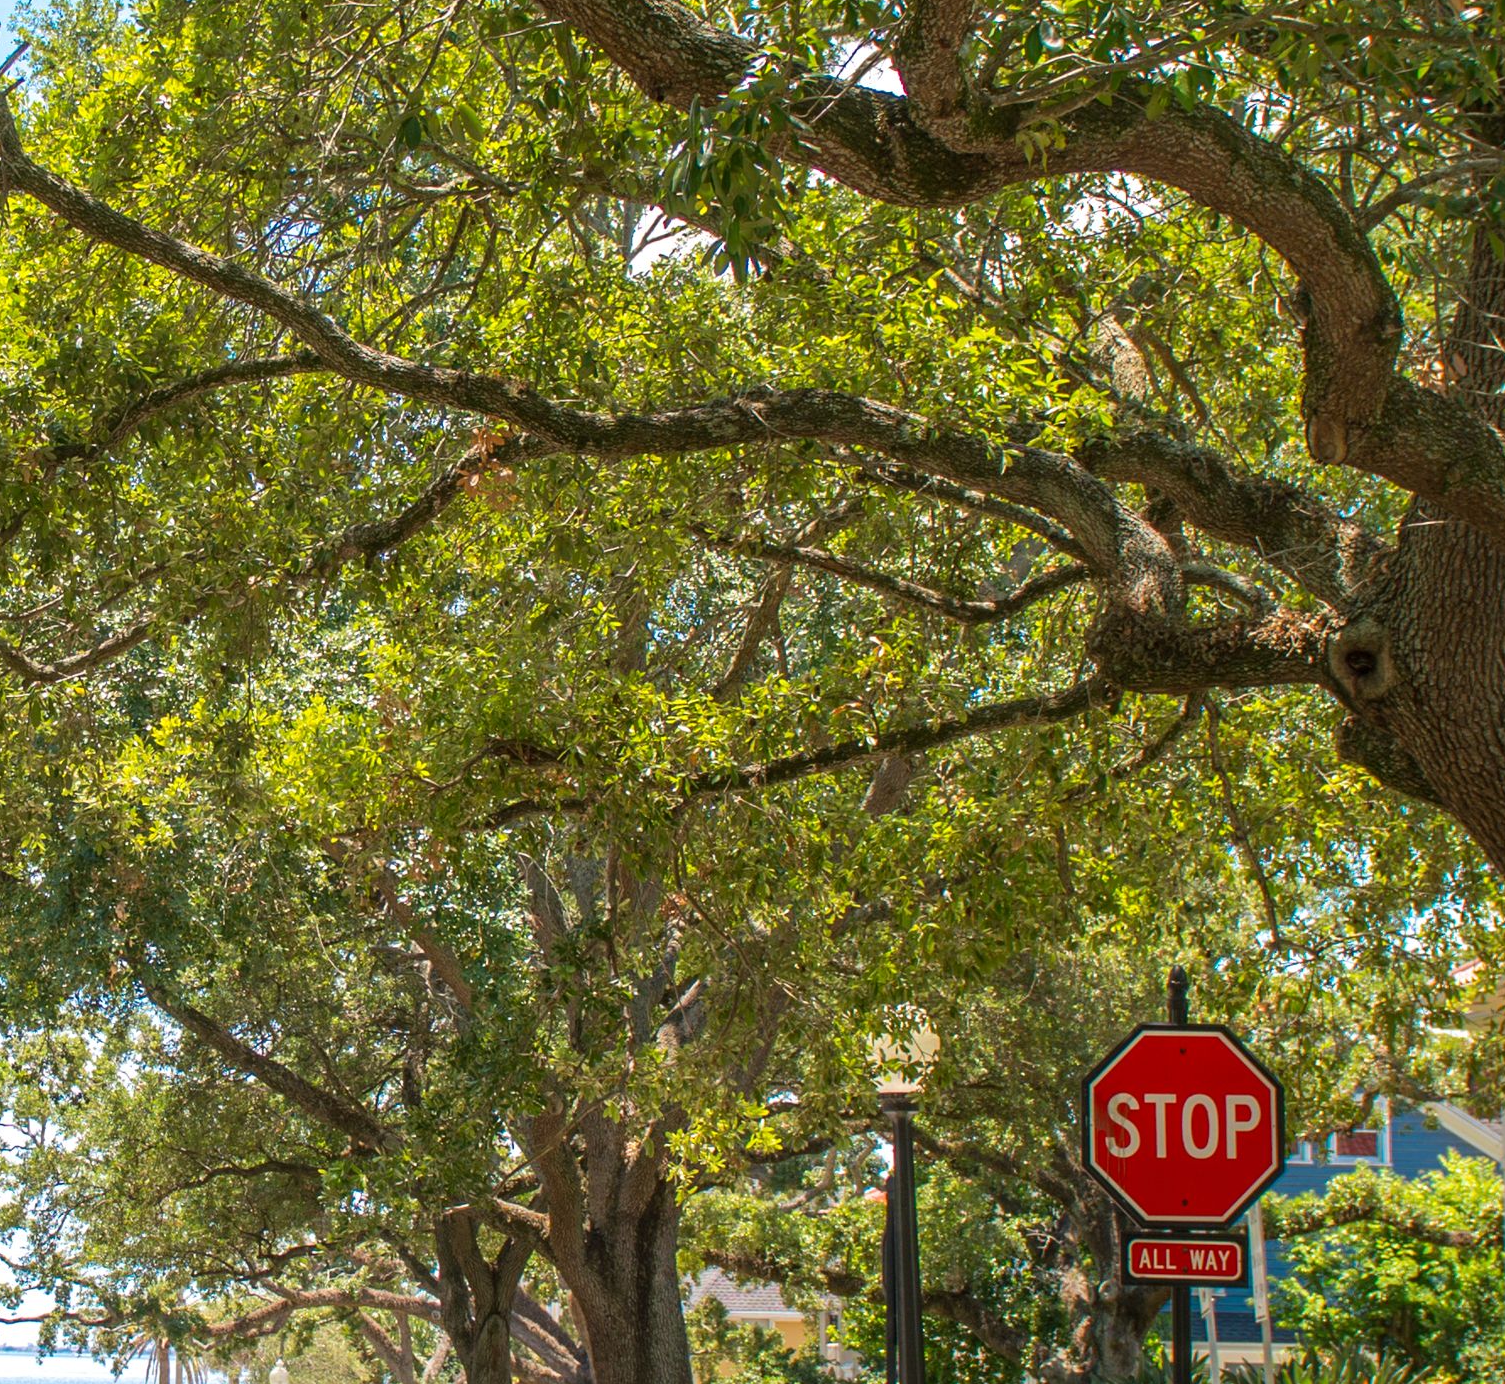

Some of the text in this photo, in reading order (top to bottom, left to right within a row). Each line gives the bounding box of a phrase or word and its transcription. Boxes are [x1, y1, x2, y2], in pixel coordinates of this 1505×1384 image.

[1105, 1092, 1261, 1159] STOP
[1139, 1248, 1230, 1271] ALL WAY
